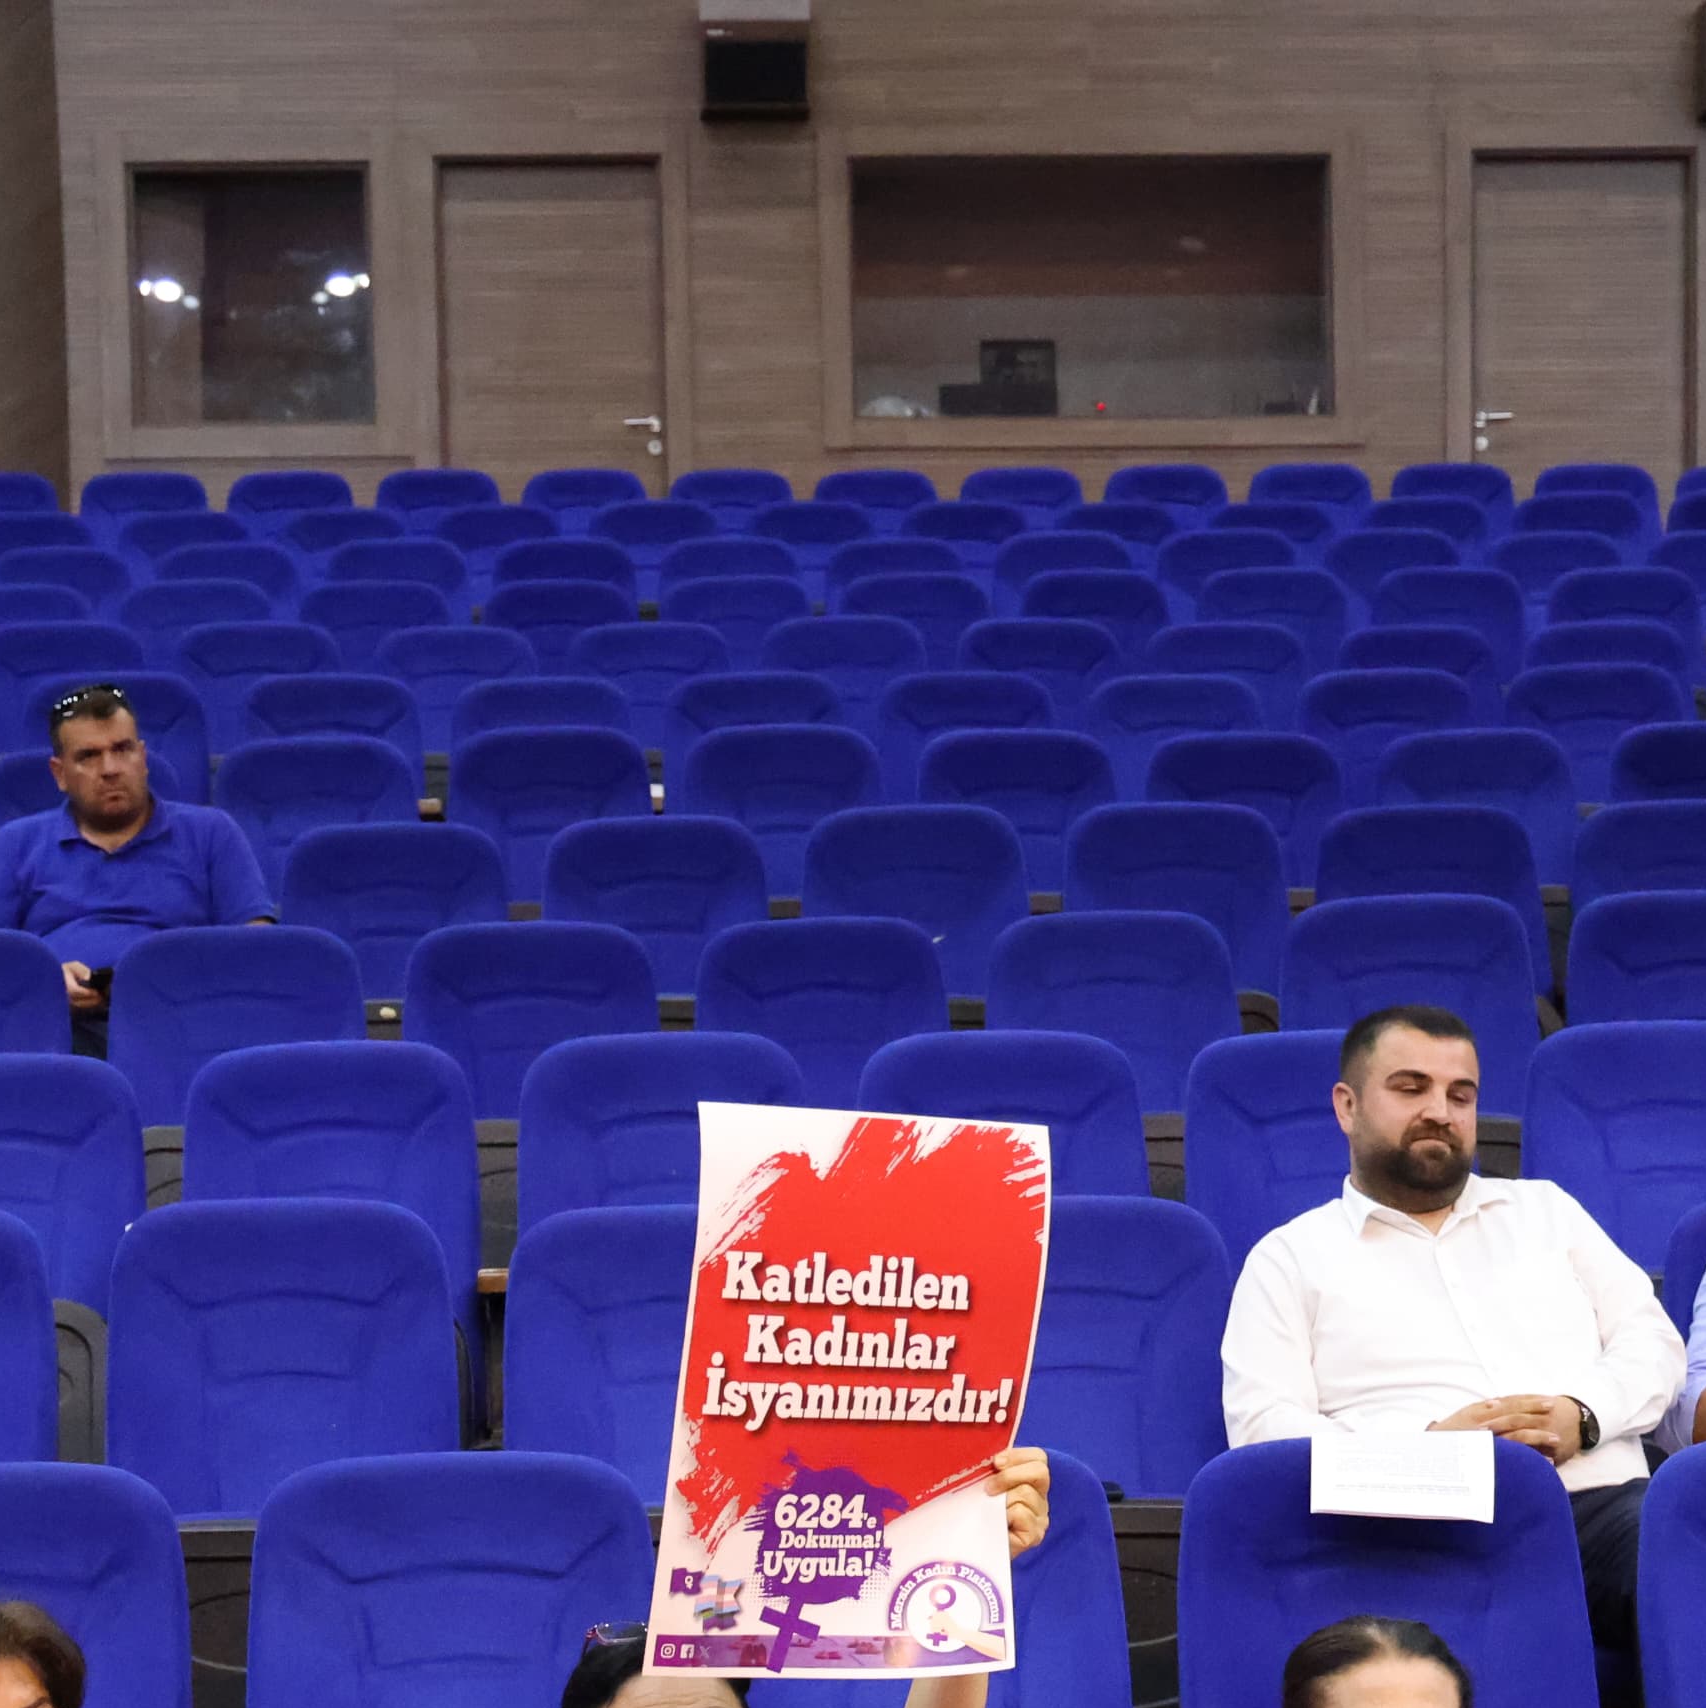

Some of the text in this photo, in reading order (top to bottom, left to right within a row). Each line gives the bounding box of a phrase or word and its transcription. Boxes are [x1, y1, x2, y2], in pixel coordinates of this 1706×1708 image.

[721, 1250, 970, 1311] Katledilen
[743, 1314, 956, 1370] Kadınlar
[701, 1351, 1014, 1432] İsyanımızdır!
[774, 1493, 878, 1529] 6284'e
[778, 1529, 883, 1549] Dokunma!
[763, 1549, 874, 1584] Uygula!
[891, 1564, 999, 1629] Mersin Kadın Platformu
